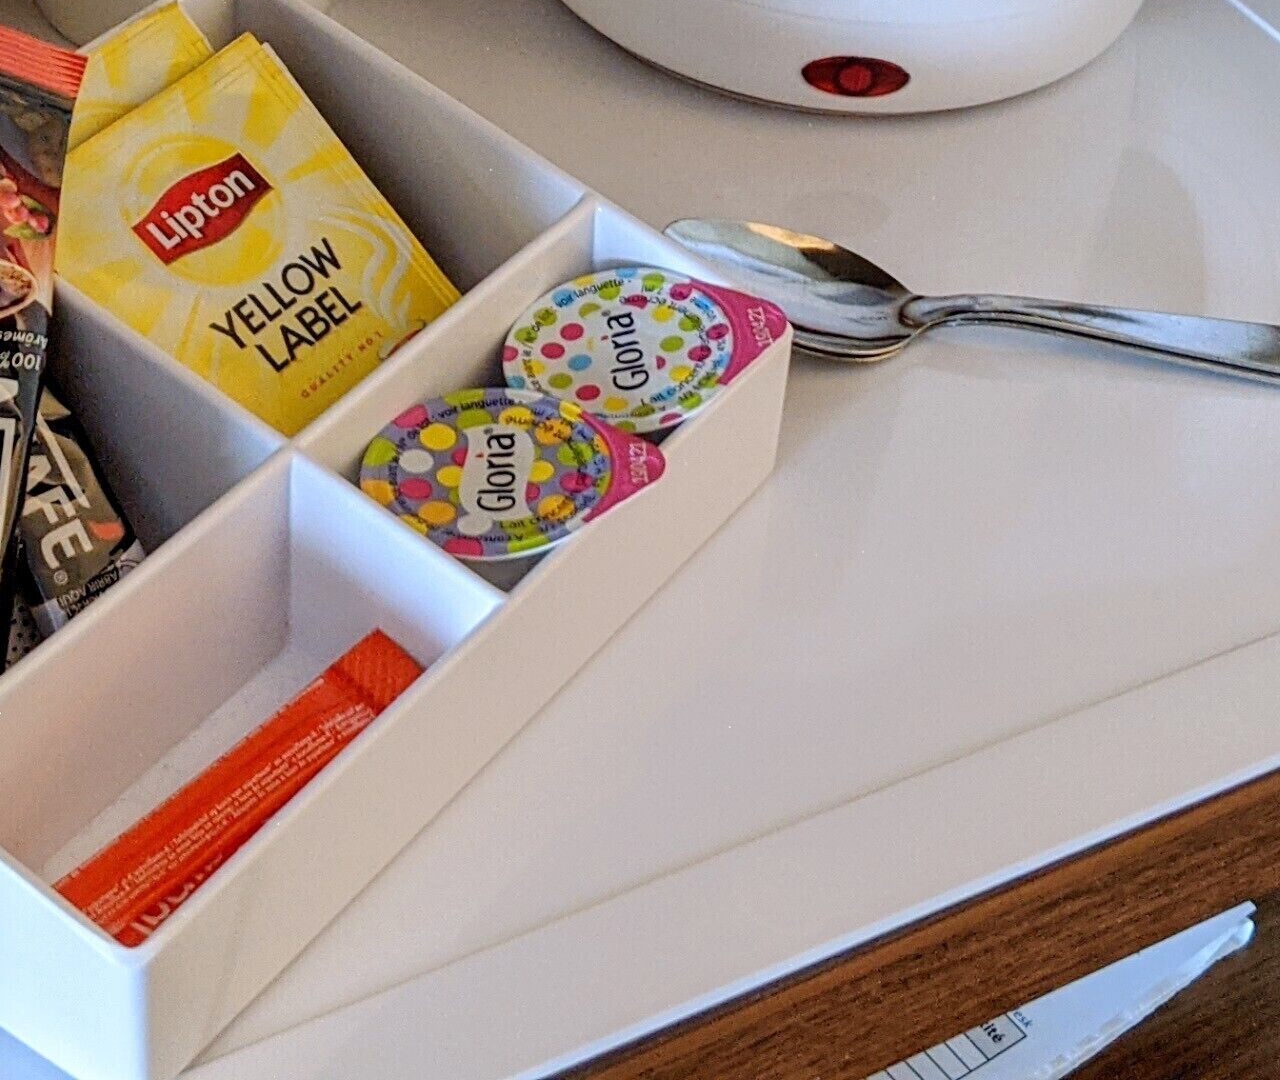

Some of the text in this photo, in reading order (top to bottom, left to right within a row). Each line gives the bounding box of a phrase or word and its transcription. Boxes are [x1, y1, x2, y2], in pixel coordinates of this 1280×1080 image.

[145, 165, 255, 251] Lipton
[208, 235, 343, 351] YELLOW
[253, 286, 363, 373] LABEL
[299, 352, 353, 399] QUALITY
[602, 310, 650, 392] Gloria
[476, 431, 516, 514] Gloria
